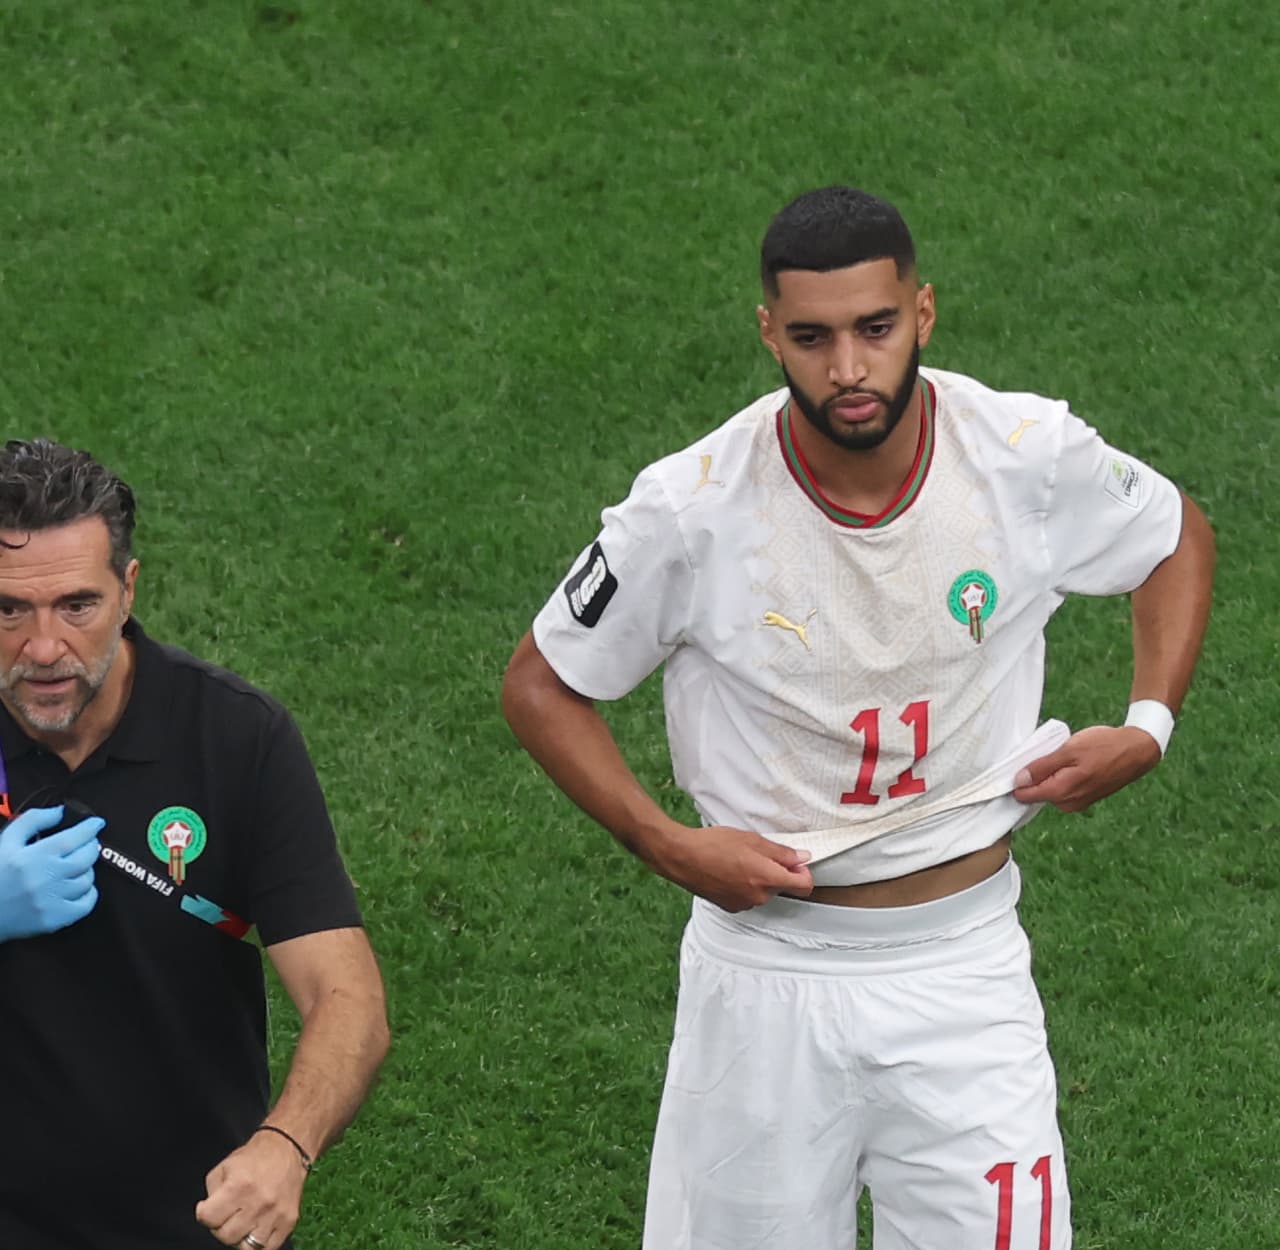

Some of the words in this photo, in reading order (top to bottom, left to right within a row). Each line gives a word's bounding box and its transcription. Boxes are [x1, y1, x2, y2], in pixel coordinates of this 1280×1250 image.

[840, 700, 930, 805] 11
[102, 848, 147, 880] WORLD
[146, 873, 174, 896] FIFA
